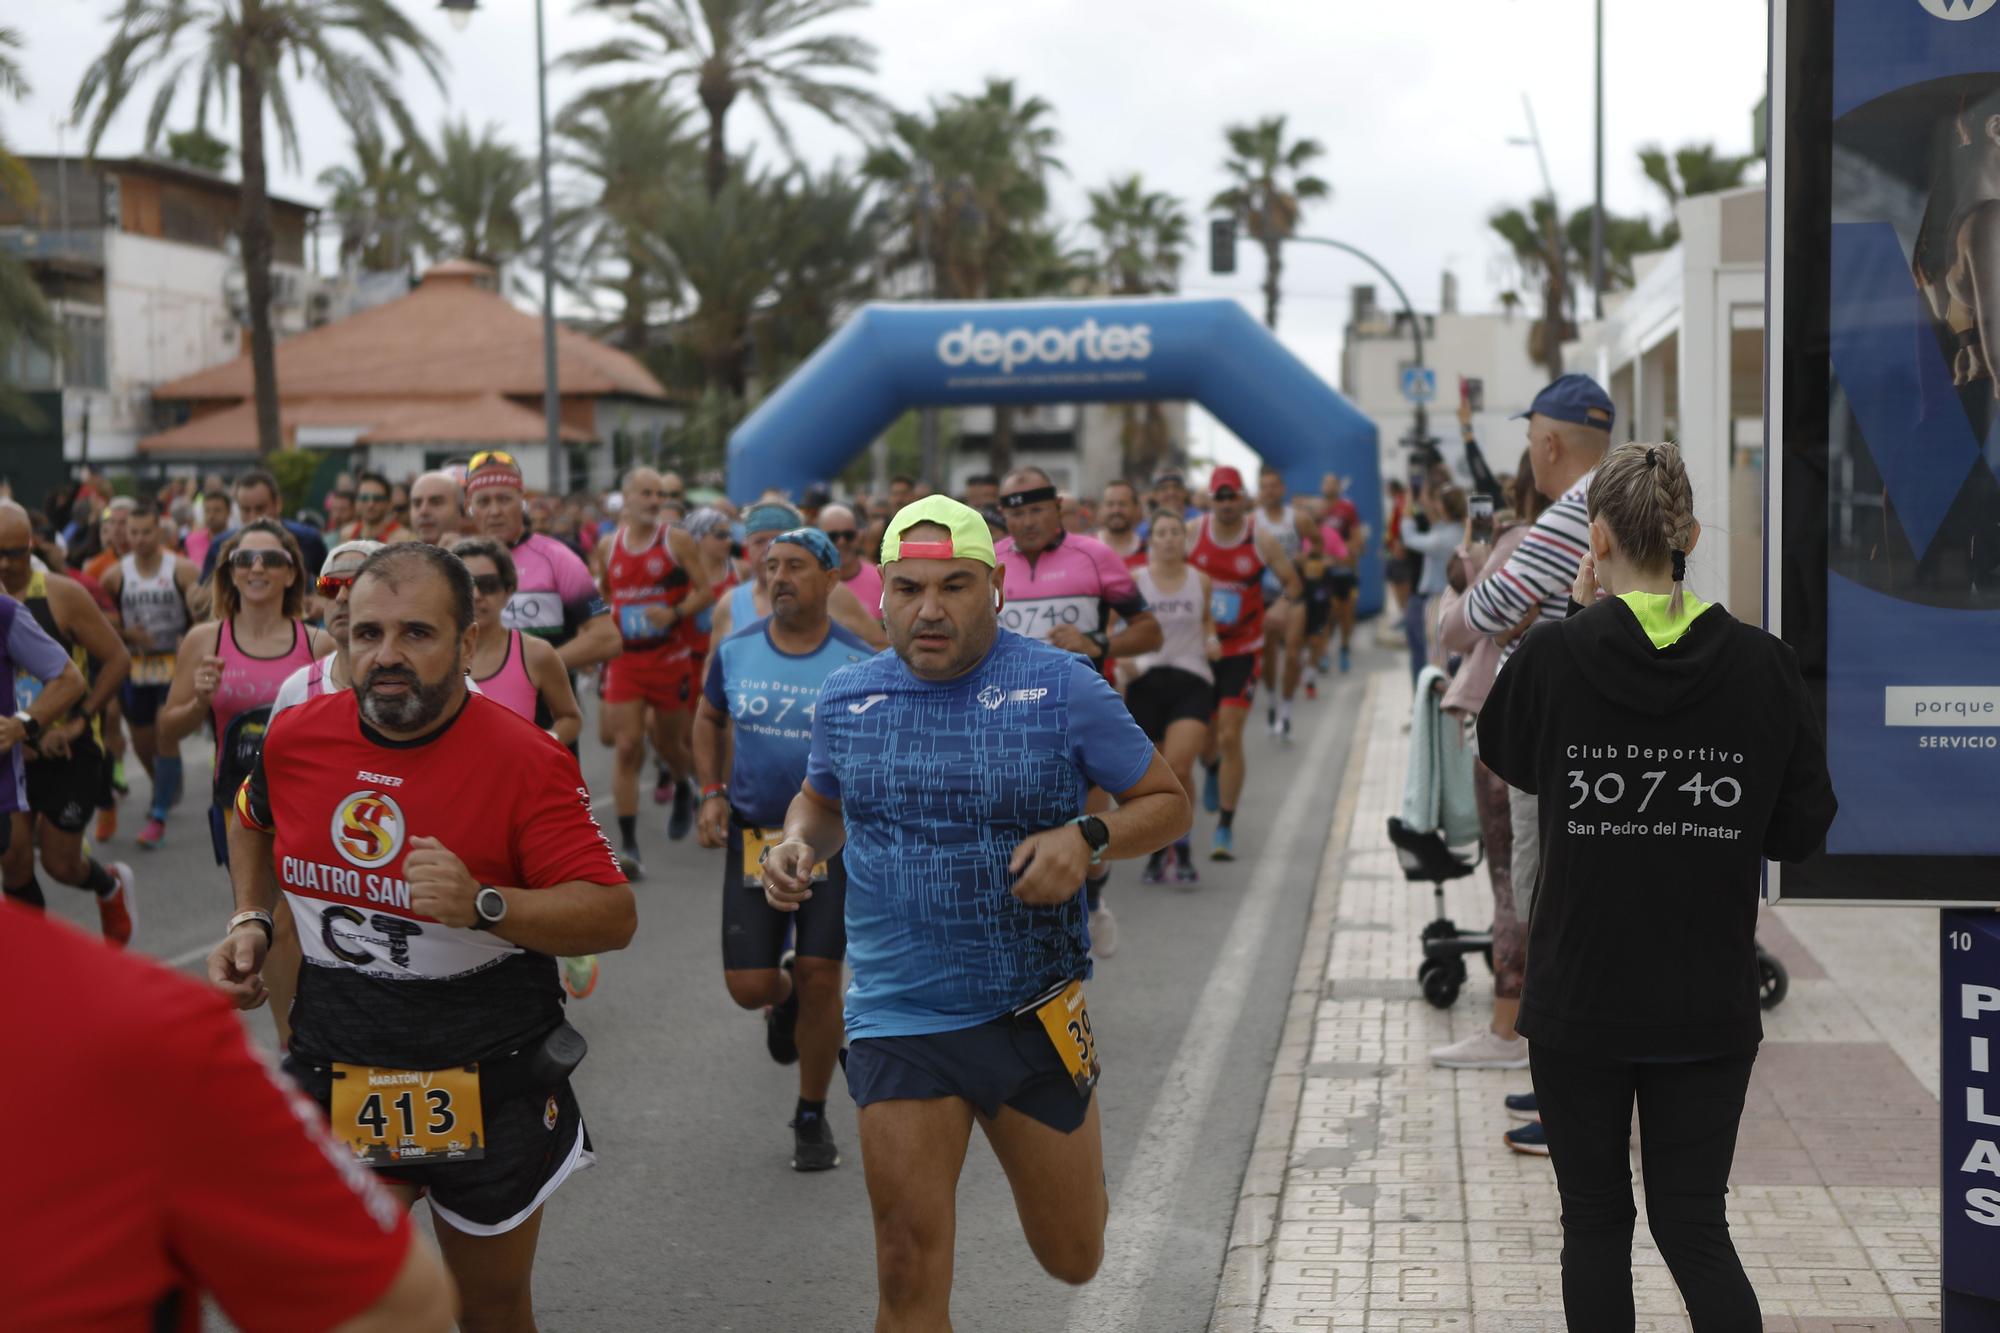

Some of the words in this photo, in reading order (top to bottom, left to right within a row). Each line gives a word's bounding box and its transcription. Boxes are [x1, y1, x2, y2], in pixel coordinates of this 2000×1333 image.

[938, 319, 1153, 374] deportes
[740, 680, 768, 689] Club
[1915, 702, 1994, 717] porque
[752, 724, 782, 736] Pedro
[784, 728, 799, 738] del
[1919, 736, 1997, 748] SERVICIO
[1567, 745, 1618, 759] Club
[1627, 745, 1744, 764] Deportivo
[356, 771, 404, 787] FASTER
[1567, 821, 1595, 835] San
[1600, 821, 1649, 835] Pedro
[1653, 822, 1677, 835] del
[1682, 822, 1742, 840] Pinatar
[282, 855, 361, 898] CUATRO
[1949, 931, 1972, 951] 10
[368, 1074, 419, 1086] MARATÓN
[356, 1088, 457, 1139] 413
